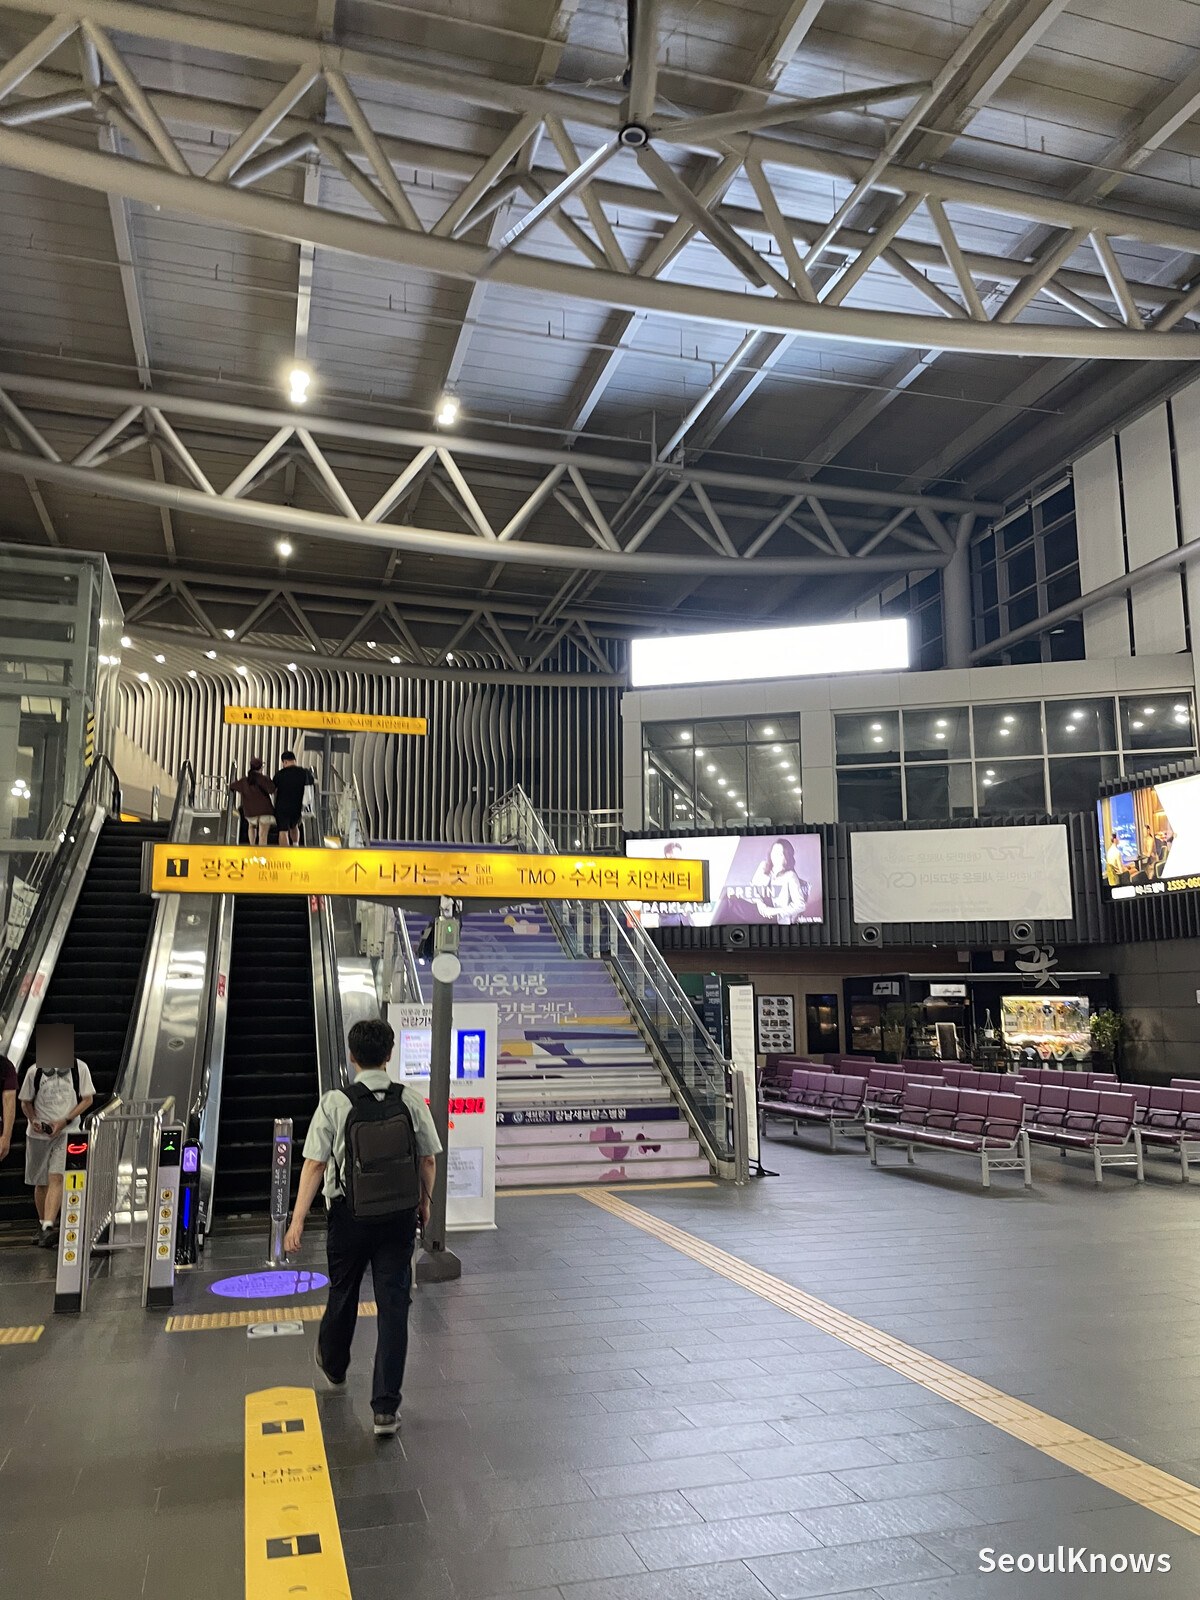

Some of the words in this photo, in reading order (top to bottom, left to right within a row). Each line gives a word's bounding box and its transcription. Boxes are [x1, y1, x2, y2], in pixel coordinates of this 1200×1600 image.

[200, 857, 246, 881] 광장
[379, 862, 442, 885] 나가는
[451, 863, 470, 886] 곳
[475, 863, 492, 875] Exit
[516, 866, 556, 886] TMO
[569, 868, 620, 889] 수서역
[627, 869, 692, 891] 치안센터
[473, 973, 548, 996] 이웃사랑
[70, 1174, 78, 1189] 1
